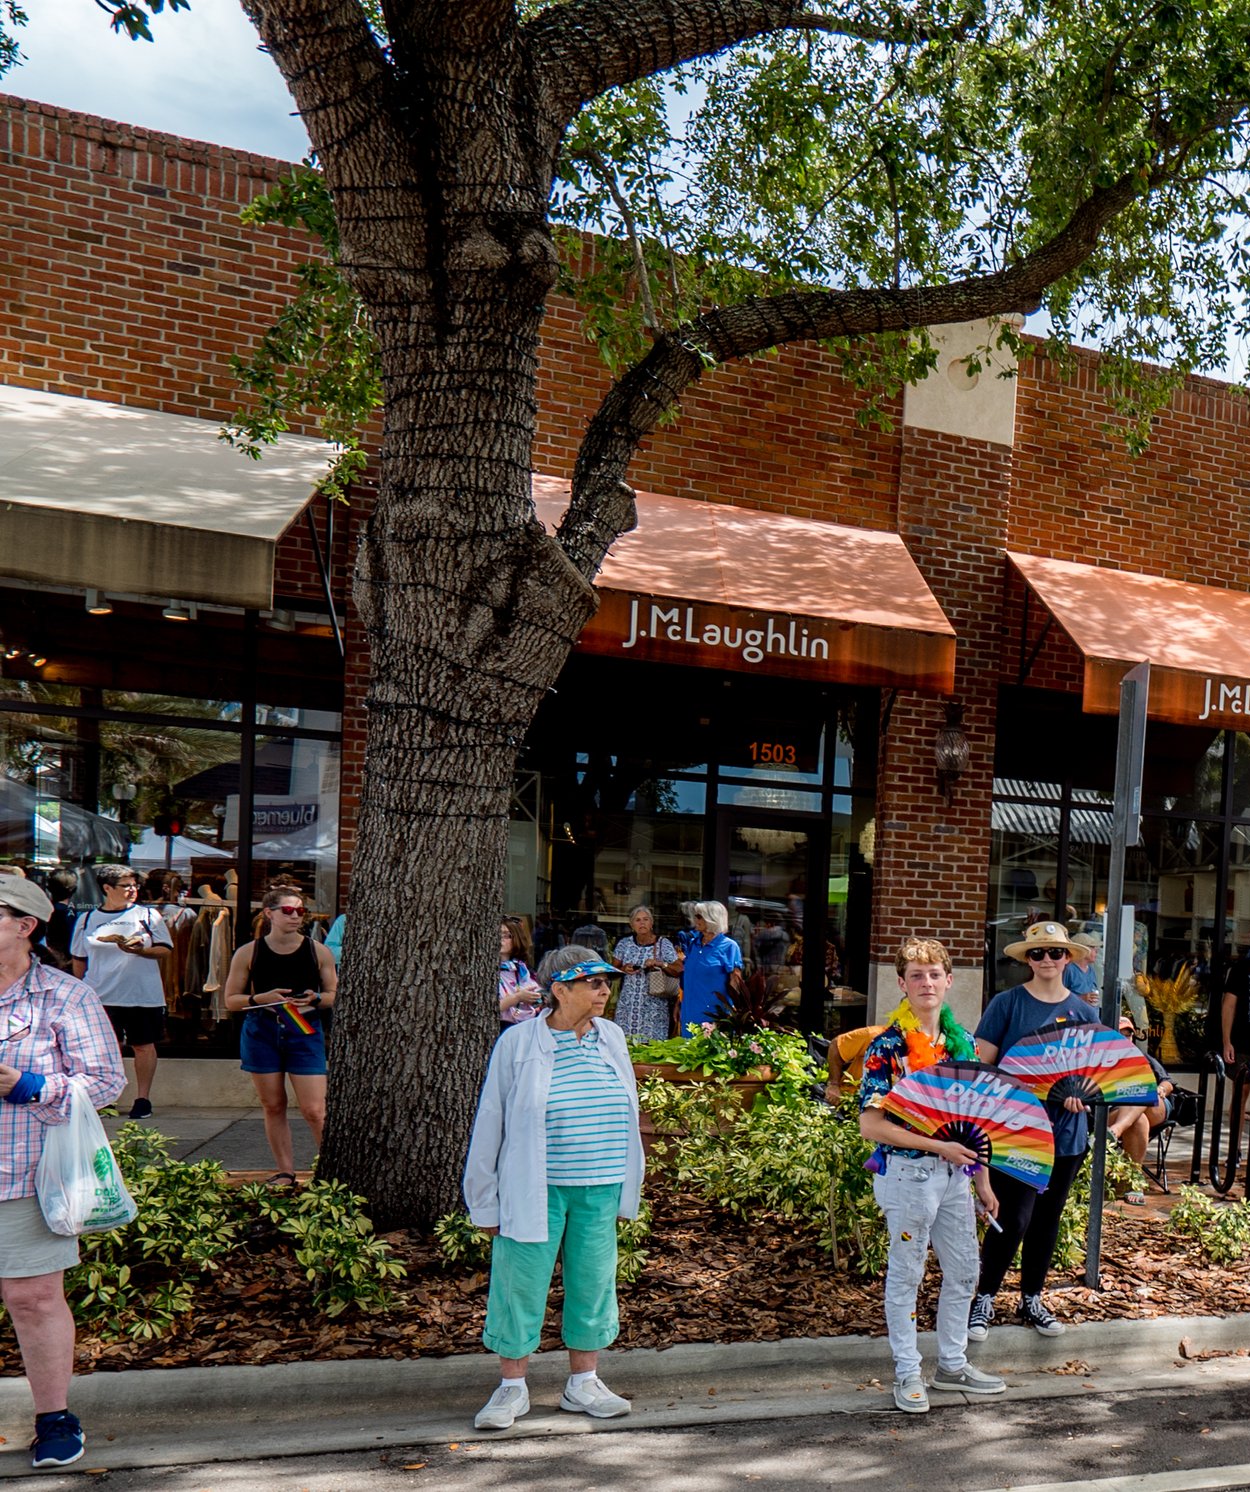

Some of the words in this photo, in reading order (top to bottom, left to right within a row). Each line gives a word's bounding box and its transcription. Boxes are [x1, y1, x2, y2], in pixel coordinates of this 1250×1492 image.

[622, 600, 828, 663] J.McLaughlin
[749, 742, 796, 764] 1503
[1061, 1028, 1094, 1048] I'M
[1041, 1045, 1121, 1068] PROUD
[972, 1072, 1013, 1100] I'M
[1116, 1086, 1149, 1096] PRIDE
[943, 1081, 1030, 1131] PROUD
[1006, 1155, 1043, 1174] PRIDE
